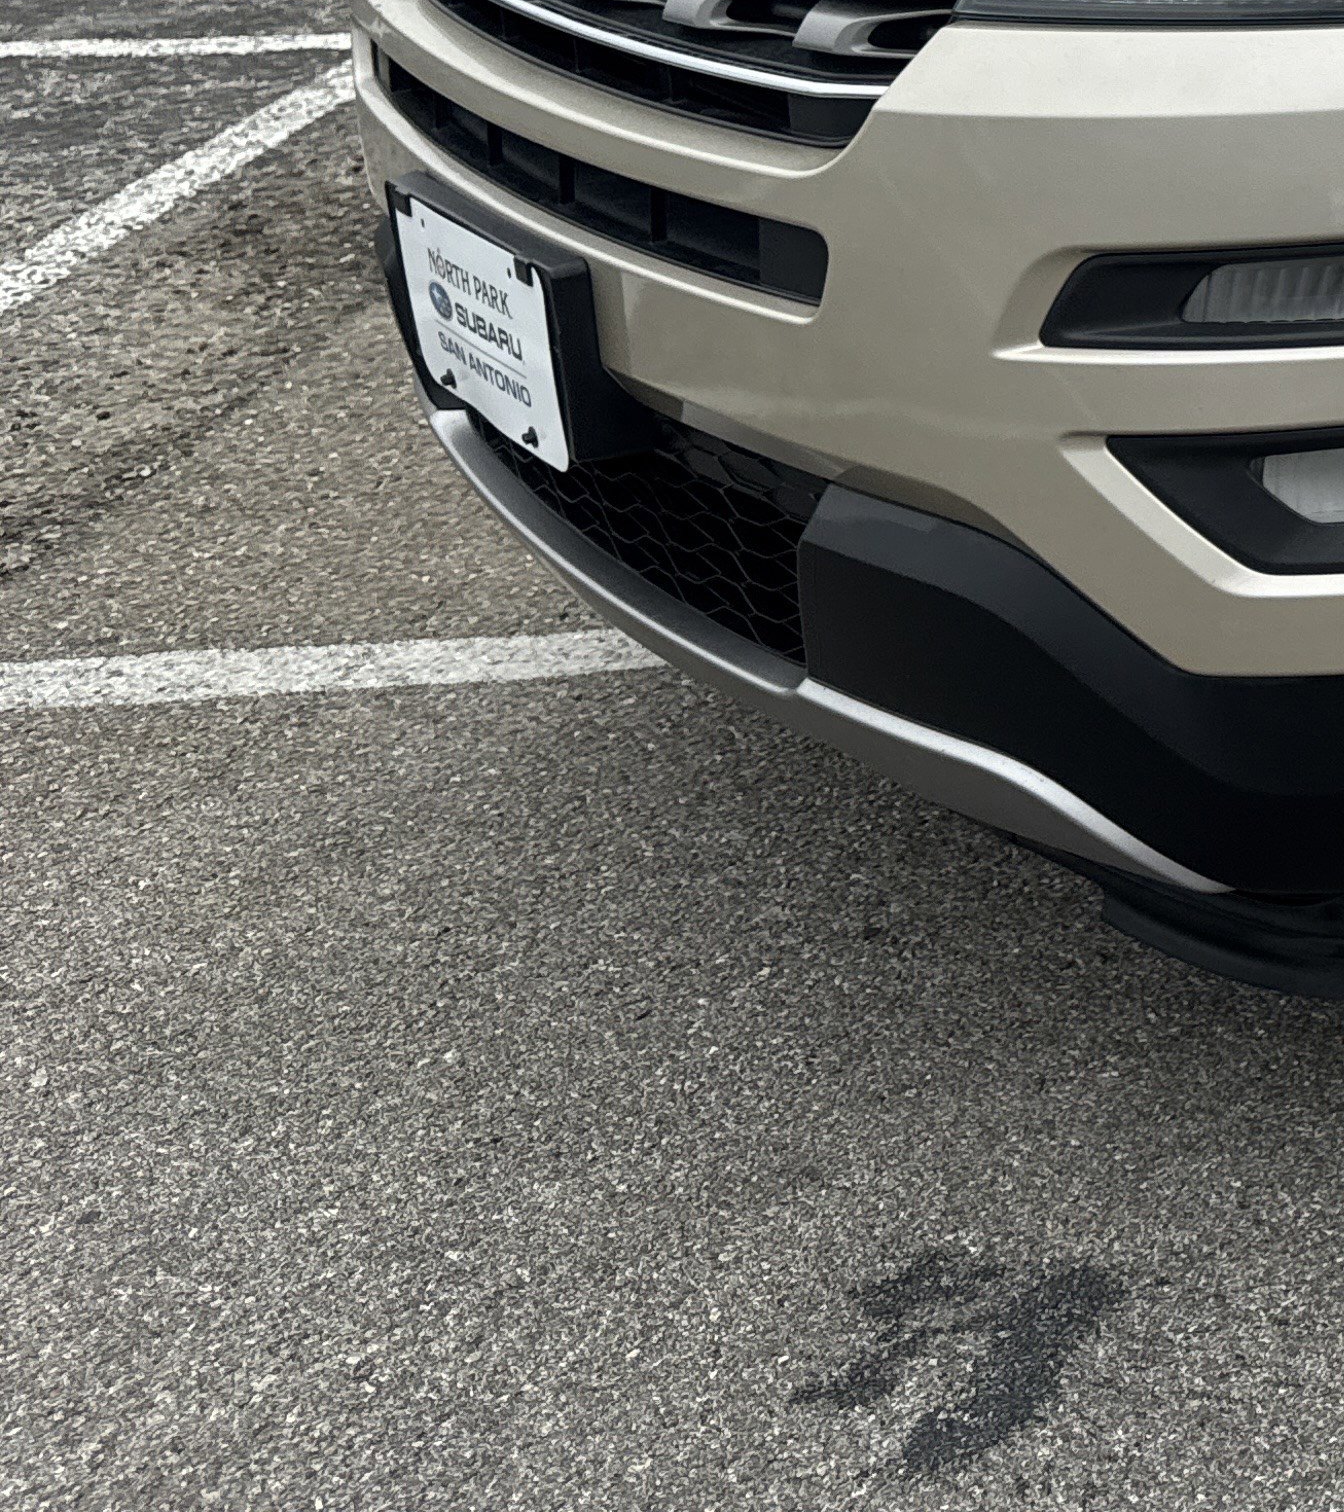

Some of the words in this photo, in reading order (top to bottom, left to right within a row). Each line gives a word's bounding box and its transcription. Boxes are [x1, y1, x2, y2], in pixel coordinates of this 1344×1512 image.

[427, 247, 471, 296] NORTH
[473, 275, 513, 320] PARK
[455, 302, 523, 361] SUBARU
[438, 331, 467, 365] SAN
[469, 353, 532, 408] ANTONIO
